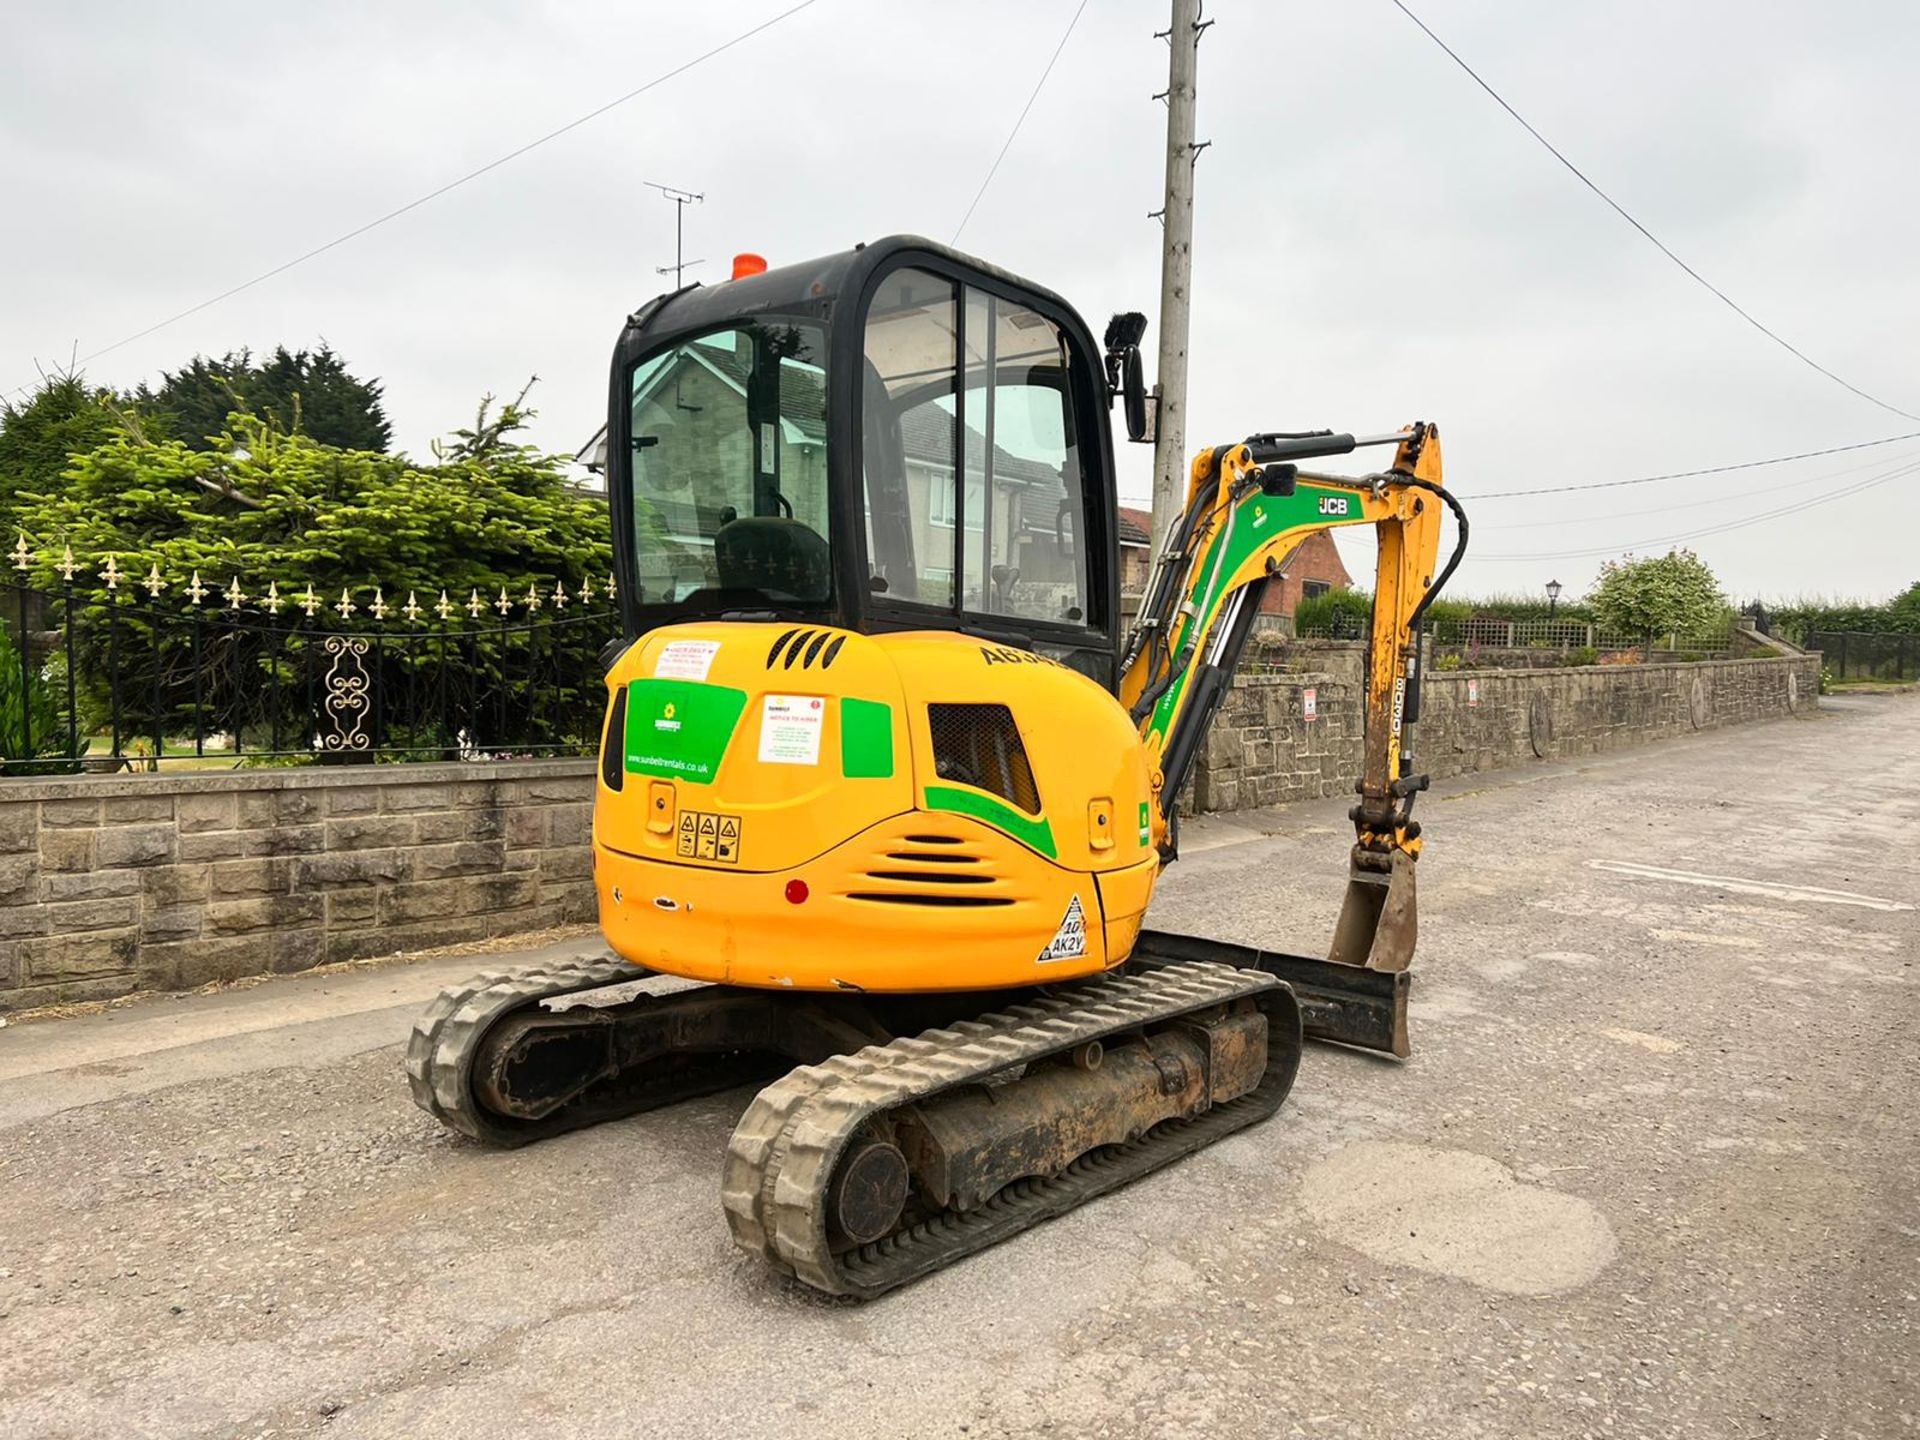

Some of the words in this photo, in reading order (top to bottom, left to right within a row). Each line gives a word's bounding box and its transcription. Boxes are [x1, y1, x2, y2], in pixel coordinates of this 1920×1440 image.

[1319, 497, 1348, 515] JCB
[1064, 921, 1081, 935] 10
[1053, 937, 1083, 952] AK2Y
